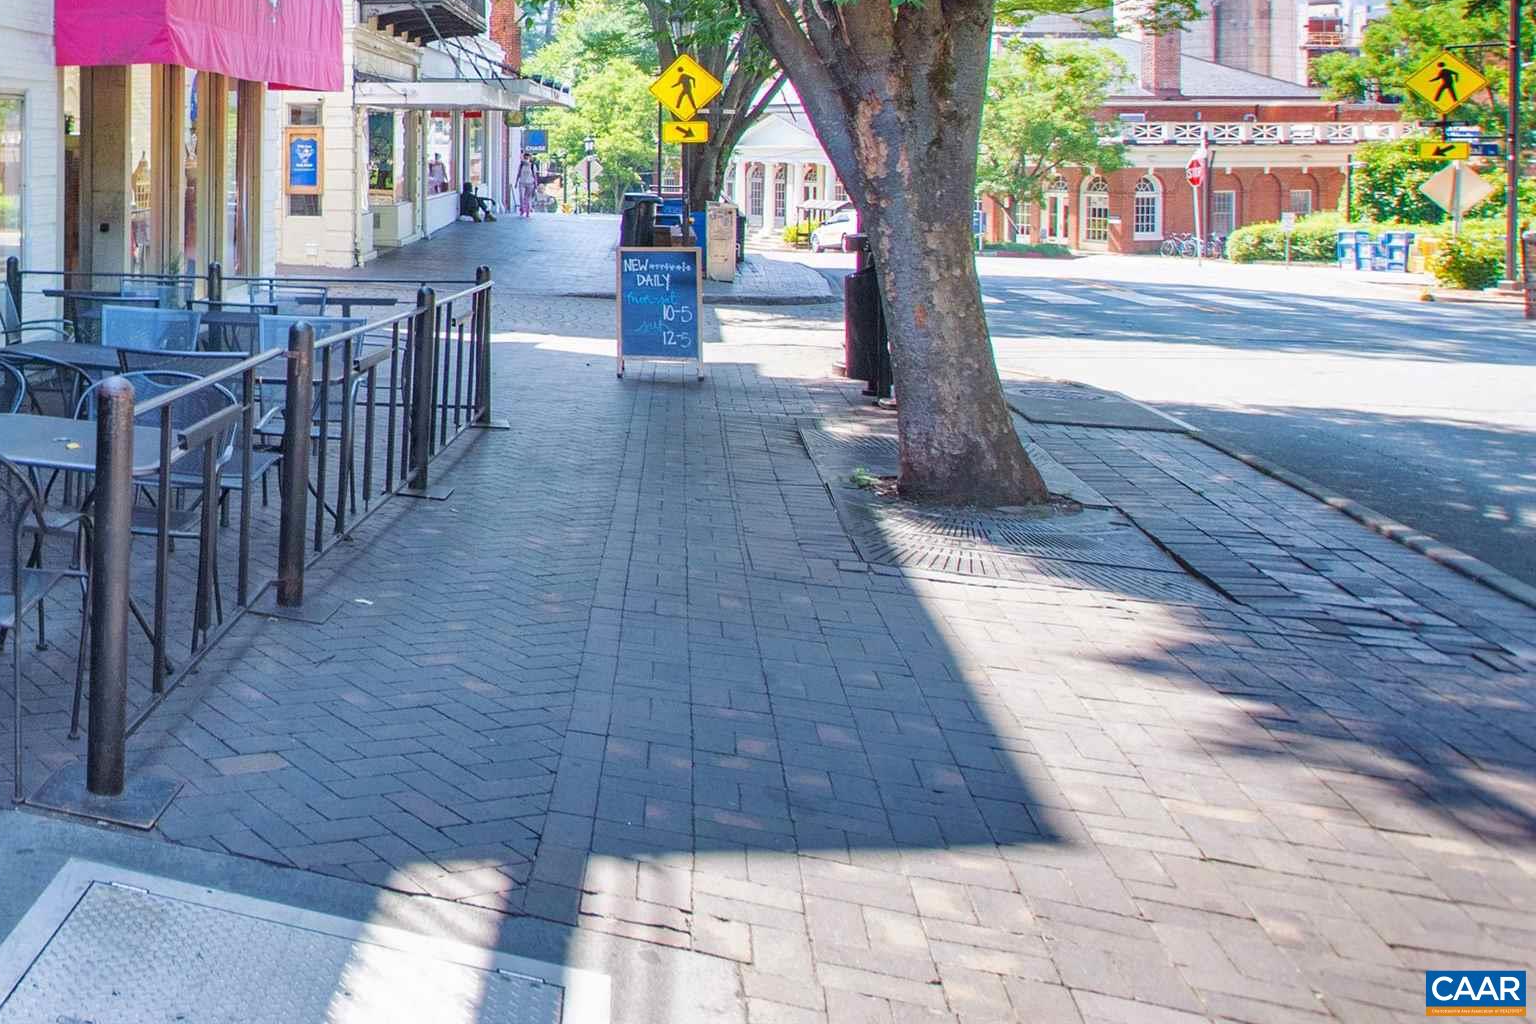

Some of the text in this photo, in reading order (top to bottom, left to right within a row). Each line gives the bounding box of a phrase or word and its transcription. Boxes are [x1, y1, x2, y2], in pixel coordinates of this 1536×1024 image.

[623, 258, 649, 273] NEW
[636, 273, 670, 291] DAILY
[663, 304, 693, 323] 10-5
[663, 331, 692, 349] 12-5
